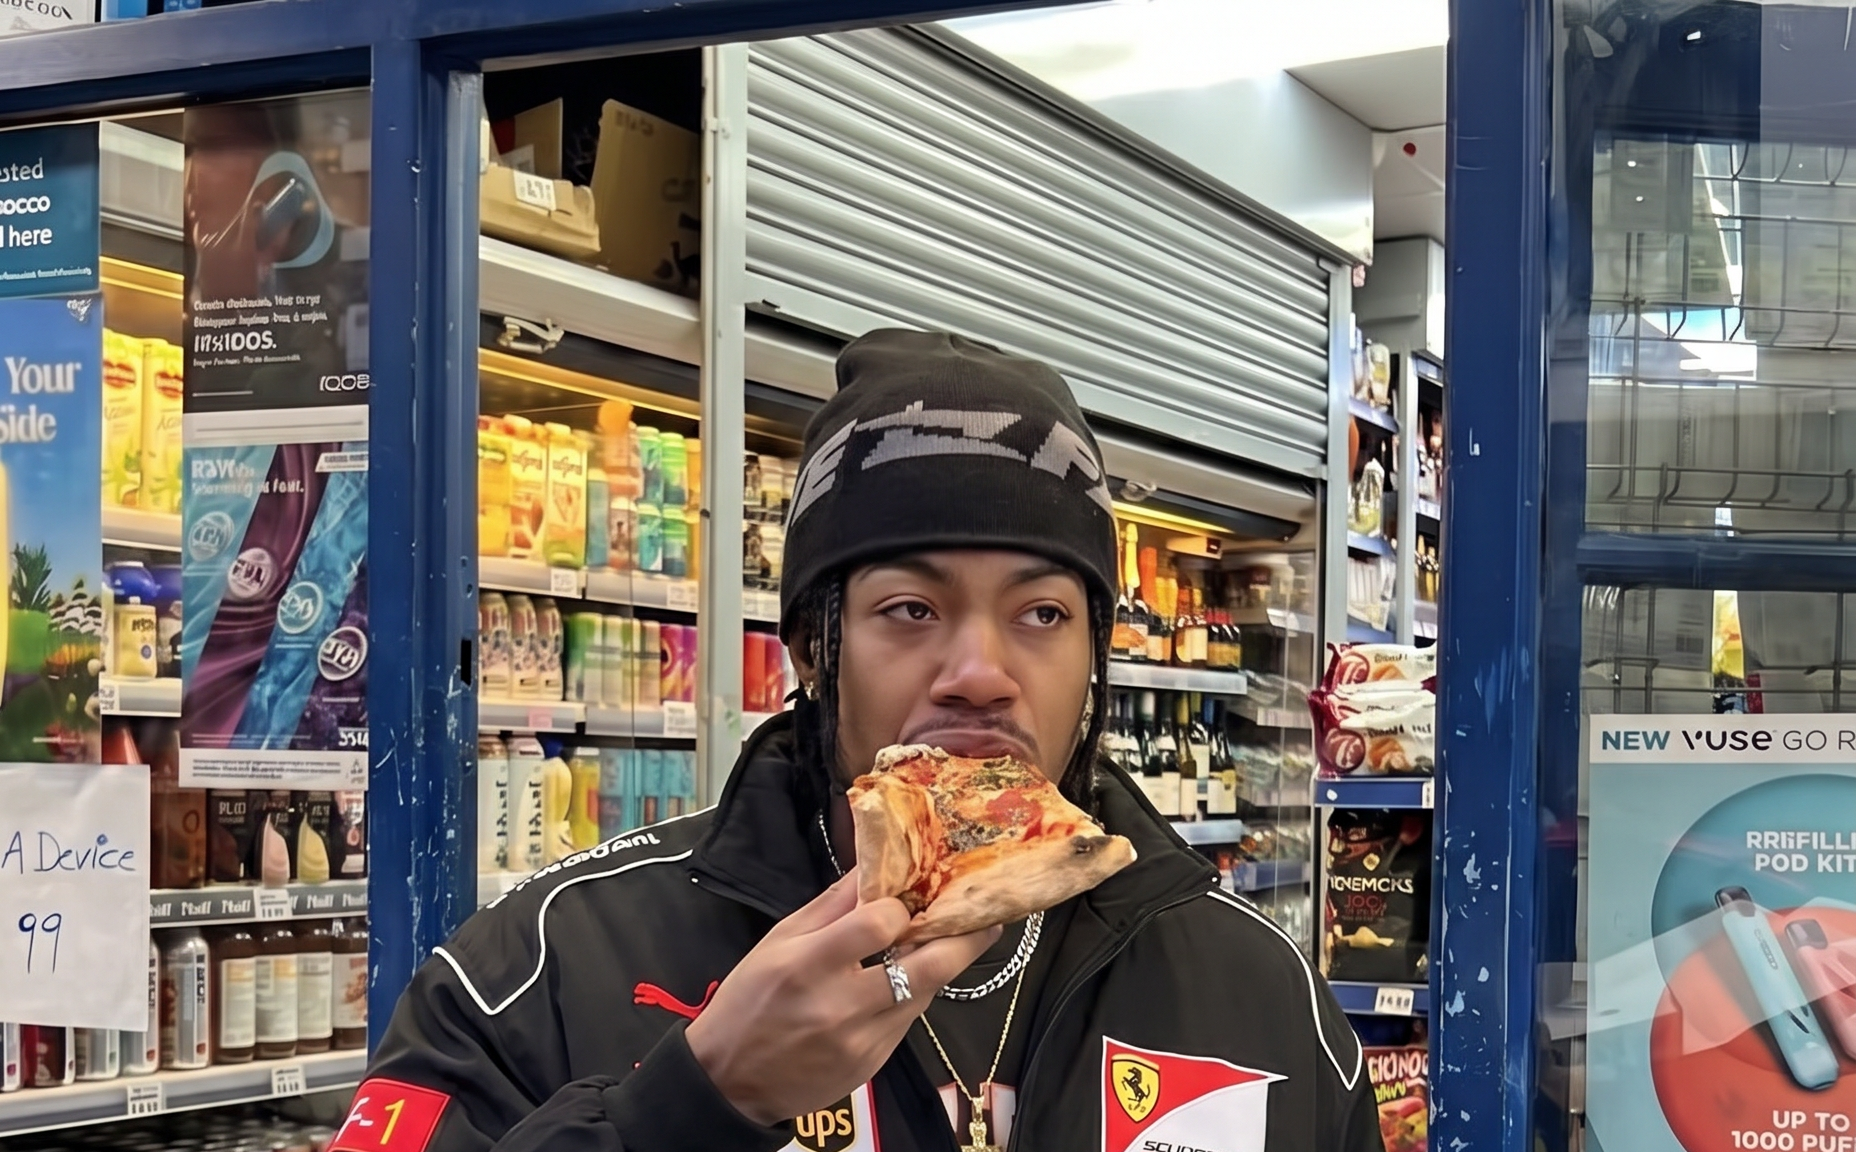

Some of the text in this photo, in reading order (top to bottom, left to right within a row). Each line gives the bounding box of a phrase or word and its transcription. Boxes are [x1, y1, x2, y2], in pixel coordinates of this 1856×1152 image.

[0, 157, 44, 182] sted
[0, 196, 51, 215] occo
[9, 225, 52, 248] here
[5, 358, 82, 395] Your
[1602, 730, 1670, 750] NEW
[1783, 730, 1827, 751] GO
[1, 831, 136, 874] A Device
[1755, 853, 1809, 872] POD
[18, 913, 62, 974] 99
[796, 1109, 852, 1147] ups
[1773, 1110, 1850, 1132] UP TO
[1731, 1131, 1794, 1151] 1000
